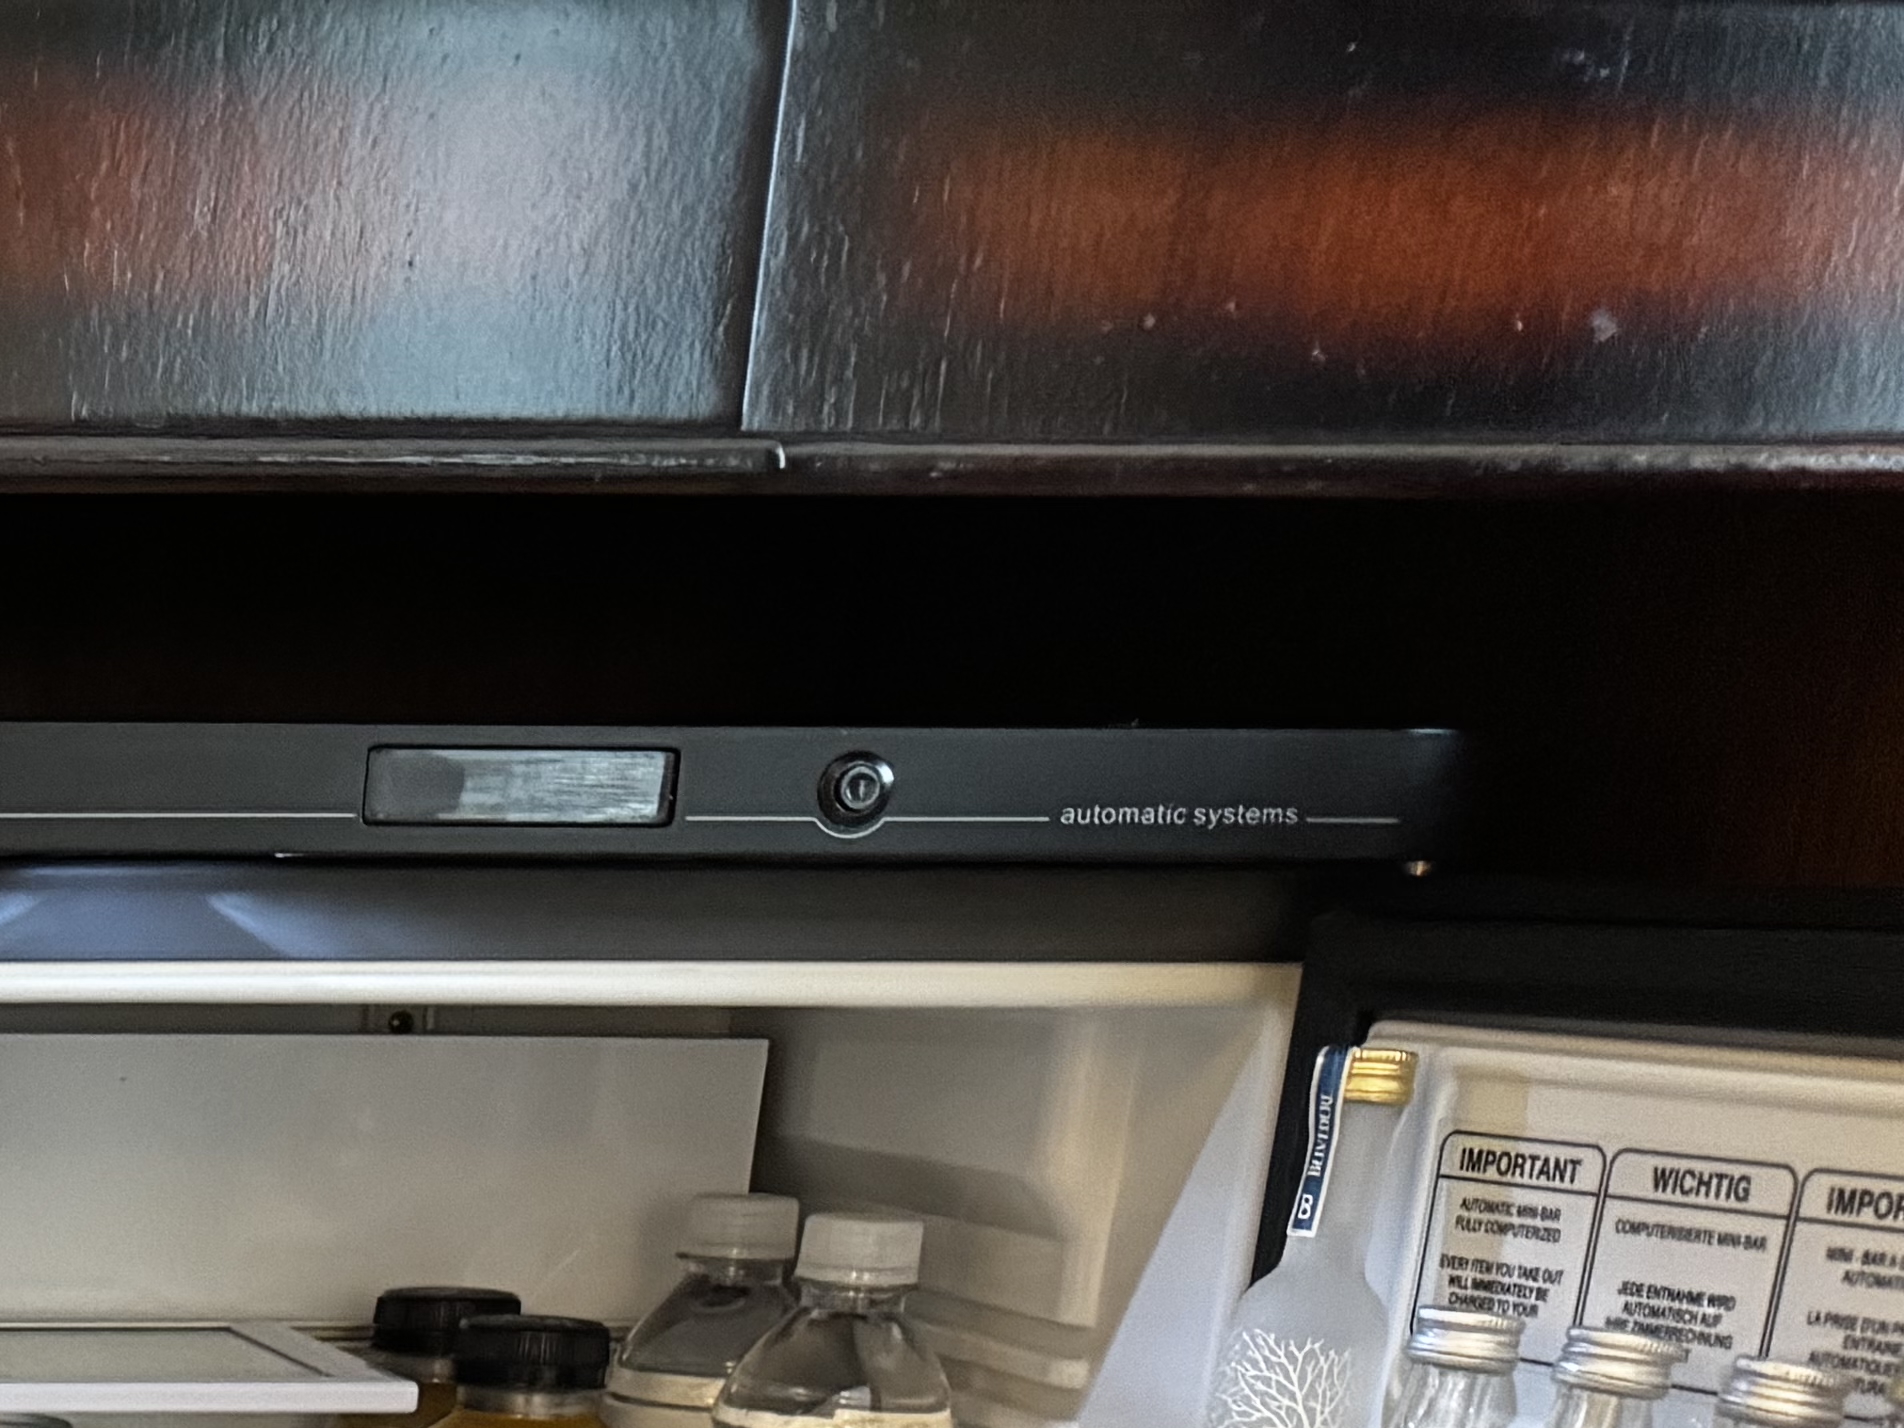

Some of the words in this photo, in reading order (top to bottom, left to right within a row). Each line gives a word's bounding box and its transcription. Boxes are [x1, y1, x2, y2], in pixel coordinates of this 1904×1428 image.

[1060, 804, 1187, 825] automatic
[1193, 804, 1299, 829] systems
[1459, 1147, 1583, 1184] IMPORTANT
[1653, 1166, 1752, 1202] WICHTIG
[1460, 1197, 1514, 1216] AUTOMATIC
[1455, 1215, 1483, 1233] FULLY
[1440, 1253, 1468, 1270] EVERY
[1495, 1262, 1516, 1278] YOU
[1517, 1264, 1541, 1282] TAKE
[1543, 1269, 1564, 1284] OUT
[1448, 1274, 1468, 1290] WILL
[1497, 1298, 1511, 1313] TO
[1512, 1300, 1539, 1318] YOUR
